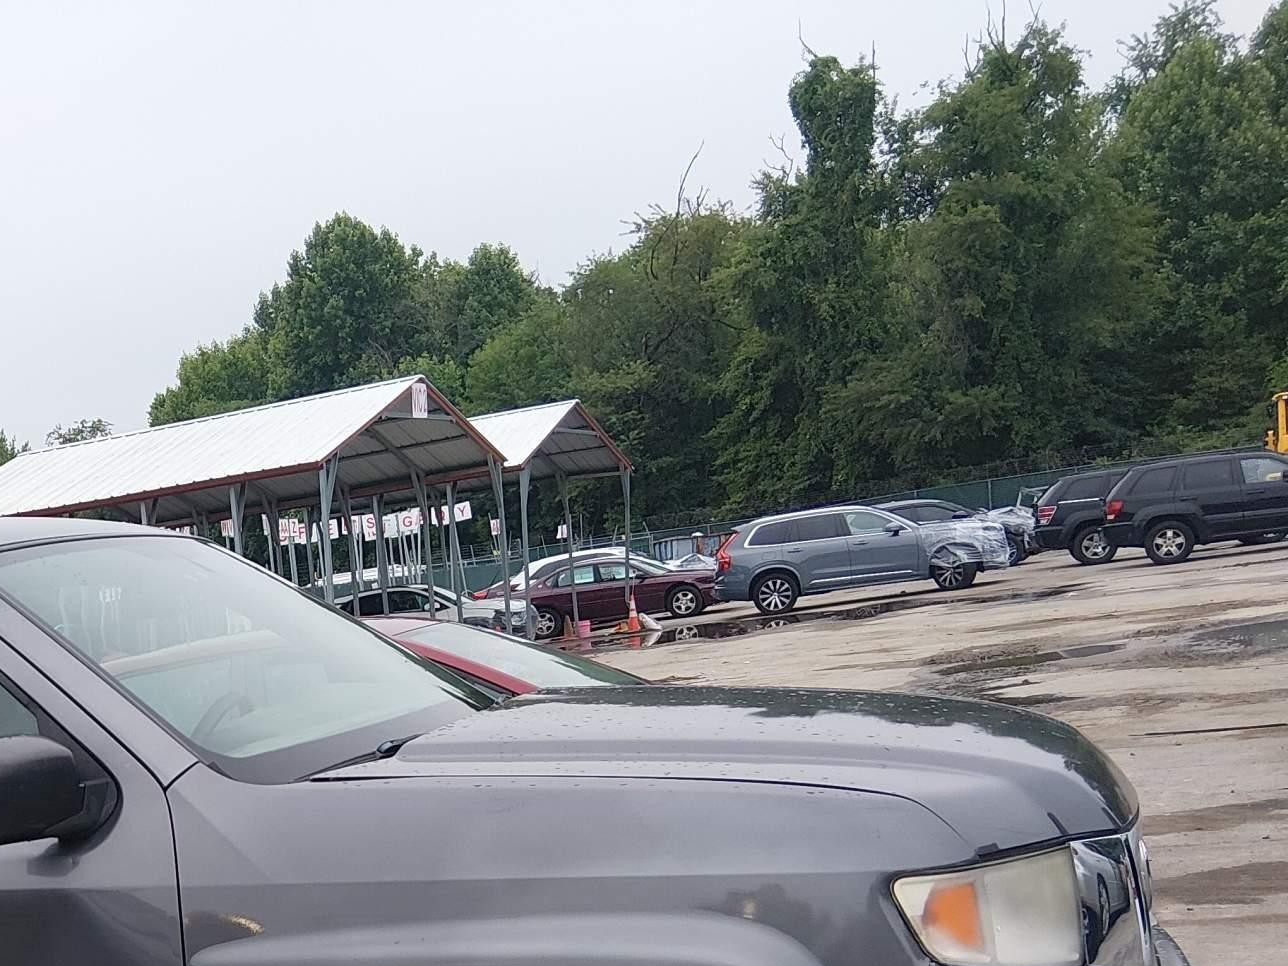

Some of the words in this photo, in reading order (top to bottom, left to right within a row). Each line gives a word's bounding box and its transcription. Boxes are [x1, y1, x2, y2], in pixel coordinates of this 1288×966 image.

[457, 506, 466, 517] Y
[366, 517, 376, 529] S
[402, 515, 413, 528] G
[298, 526, 305, 539] F
